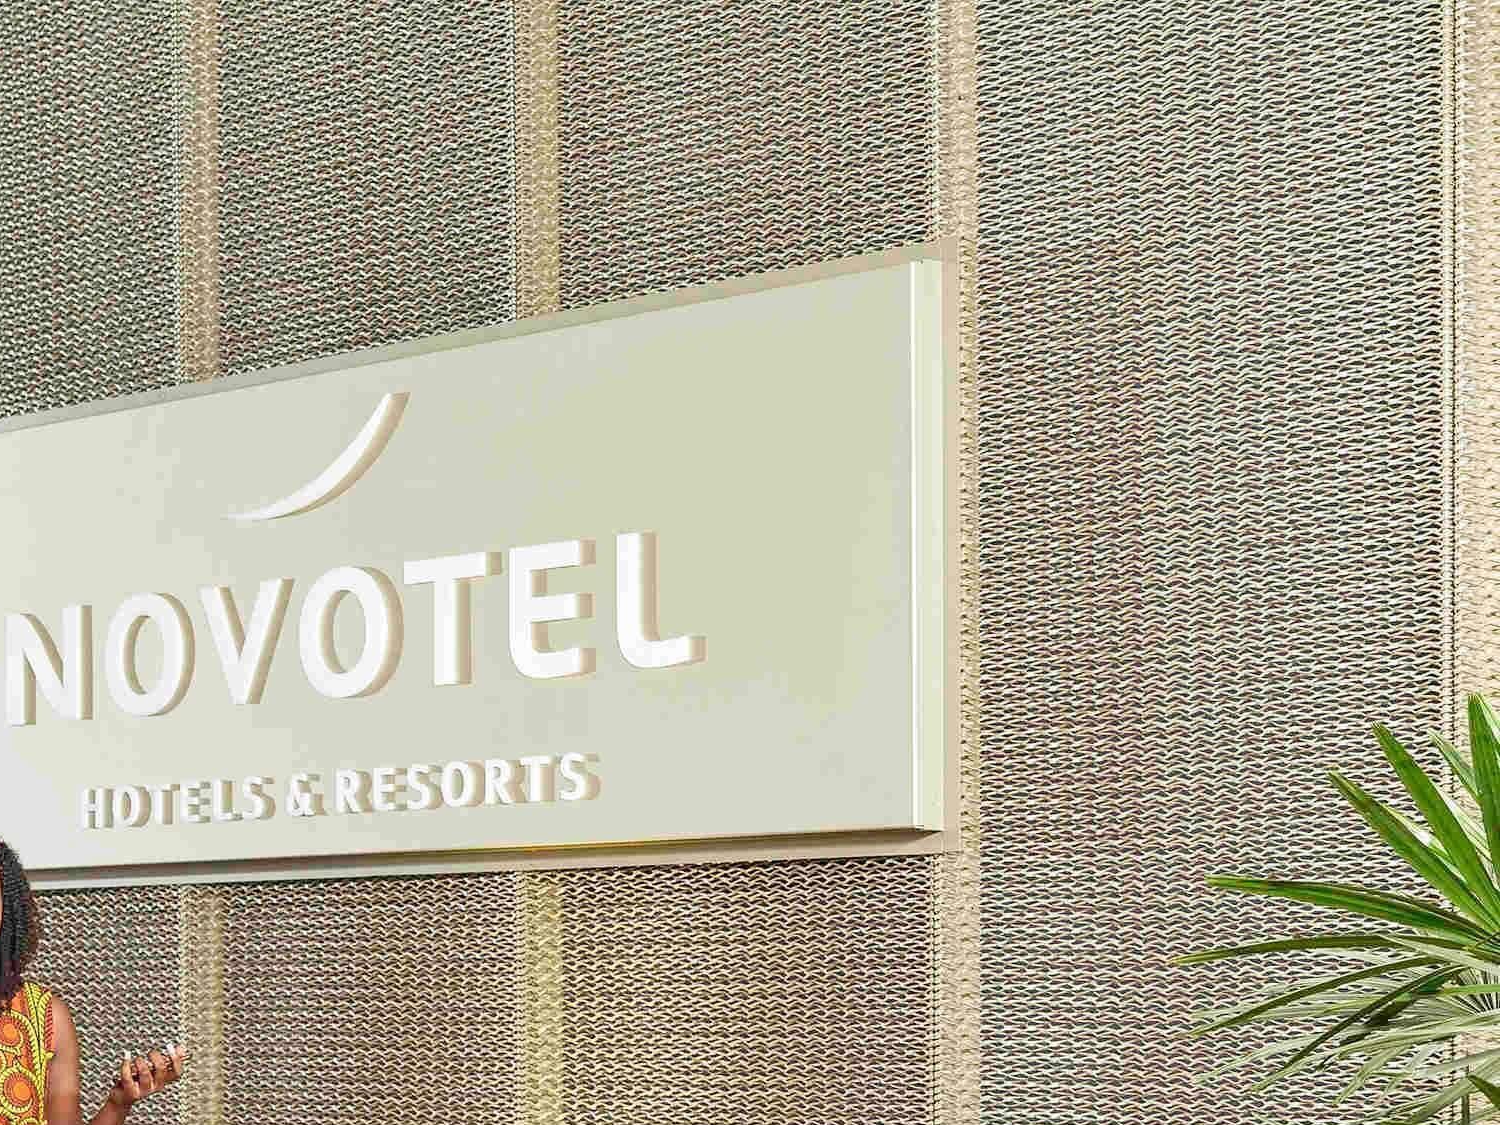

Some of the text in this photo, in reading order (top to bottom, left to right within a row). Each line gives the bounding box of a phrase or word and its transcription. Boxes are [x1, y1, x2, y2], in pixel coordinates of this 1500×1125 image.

[4, 530, 706, 726] NOVOTEL
[81, 751, 601, 830] HOTELS & RESORTS
